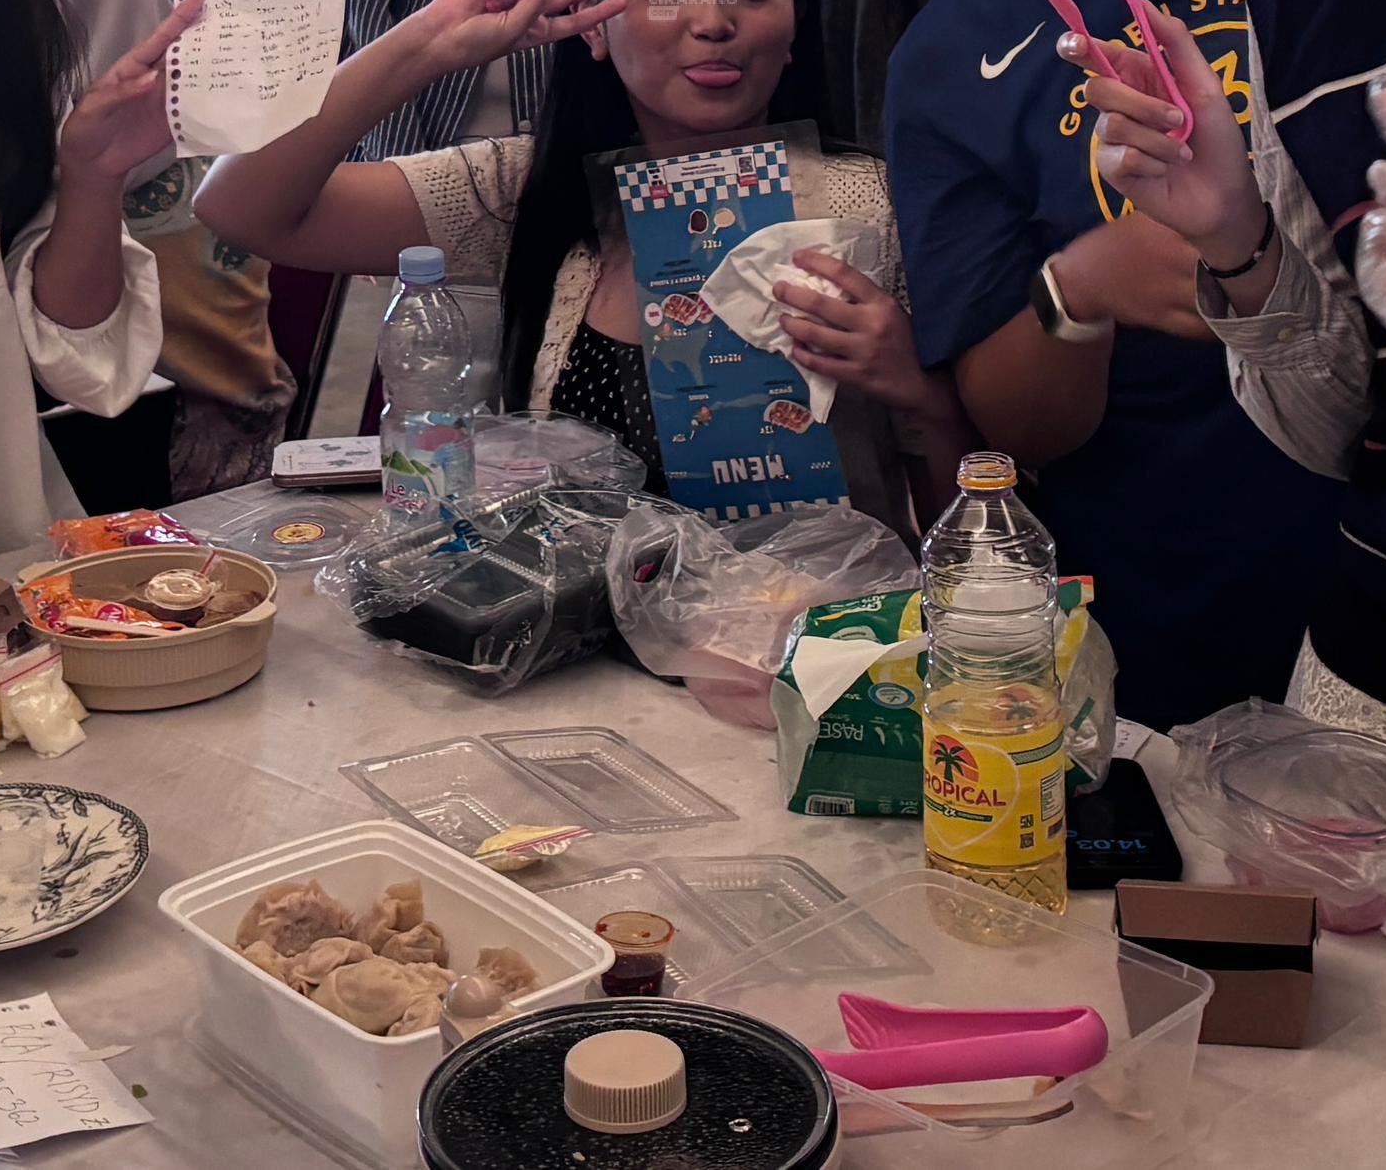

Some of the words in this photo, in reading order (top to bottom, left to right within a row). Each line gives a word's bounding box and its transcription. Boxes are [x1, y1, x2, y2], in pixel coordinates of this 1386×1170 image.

[712, 453, 786, 486] MENU
[817, 720, 864, 742] PASE
[924, 770, 1007, 808] ROPICAL
[1075, 837, 1149, 851] 14.03
